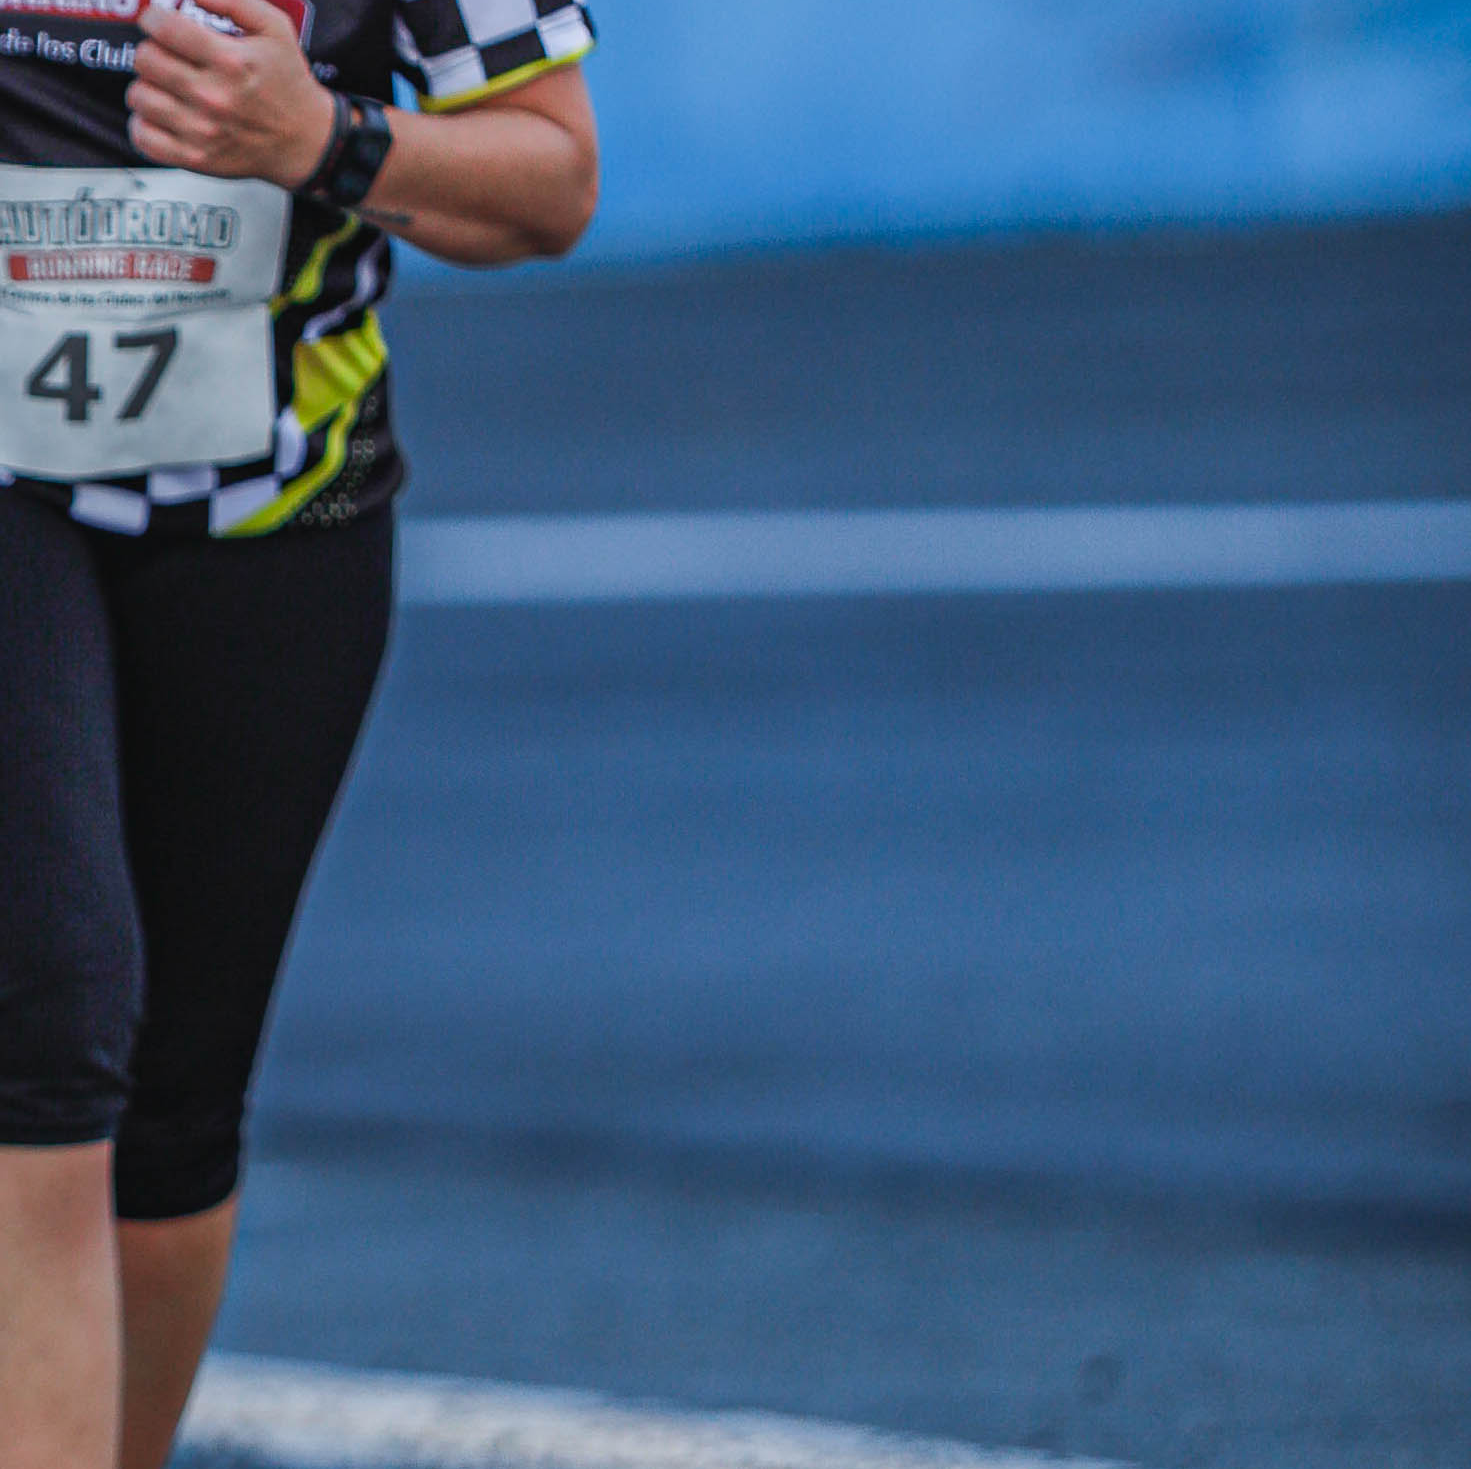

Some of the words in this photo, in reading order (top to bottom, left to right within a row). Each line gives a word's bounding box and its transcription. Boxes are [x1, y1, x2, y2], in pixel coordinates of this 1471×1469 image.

[37, 31, 77, 65] los
[27, 253, 132, 280] RUNNING
[27, 327, 180, 422] 47
